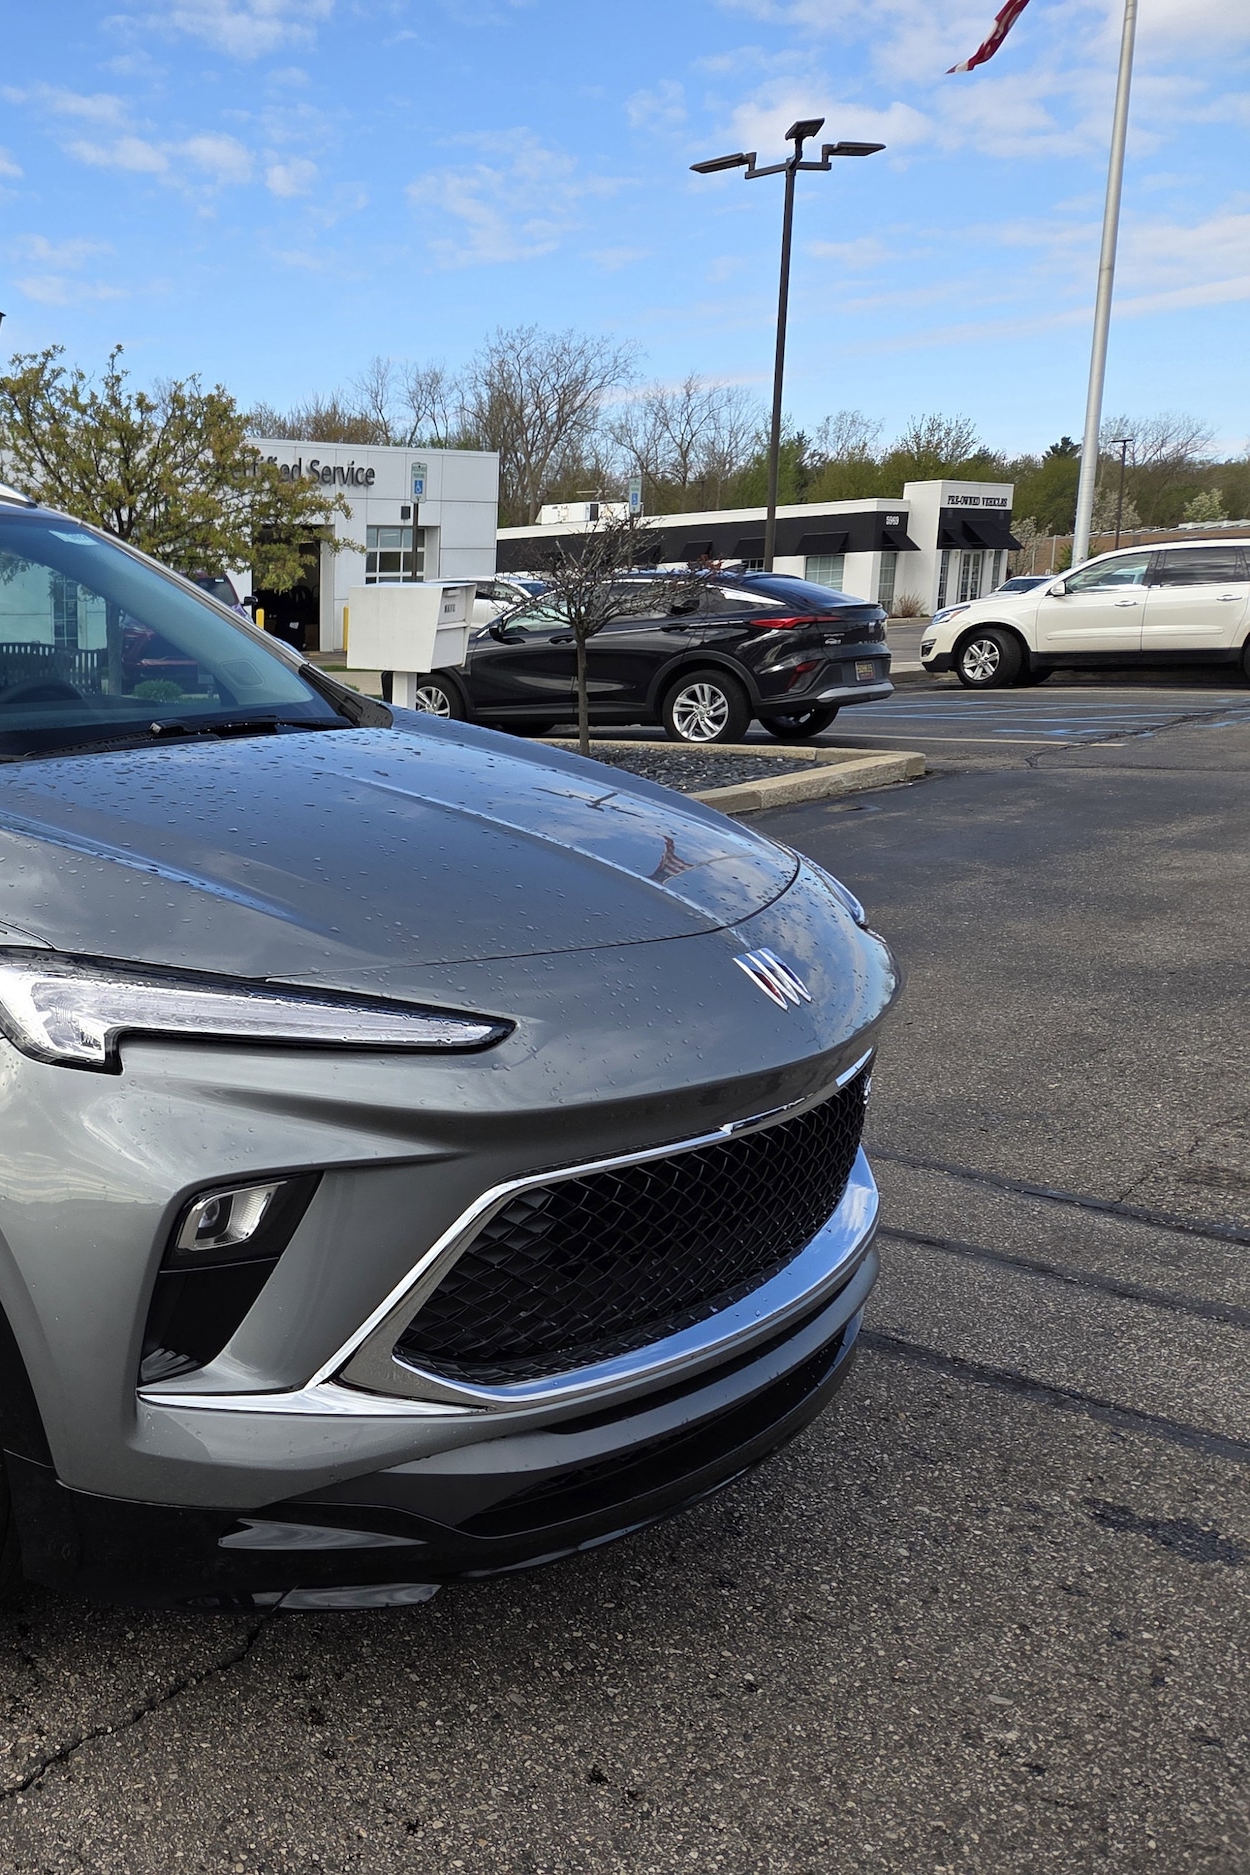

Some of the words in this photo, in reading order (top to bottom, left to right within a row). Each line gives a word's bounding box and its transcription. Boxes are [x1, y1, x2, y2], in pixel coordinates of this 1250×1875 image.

[308, 459, 376, 486] Service
[947, 495, 981, 507] PRE-OWNED
[982, 497, 1008, 508] VEHICLES
